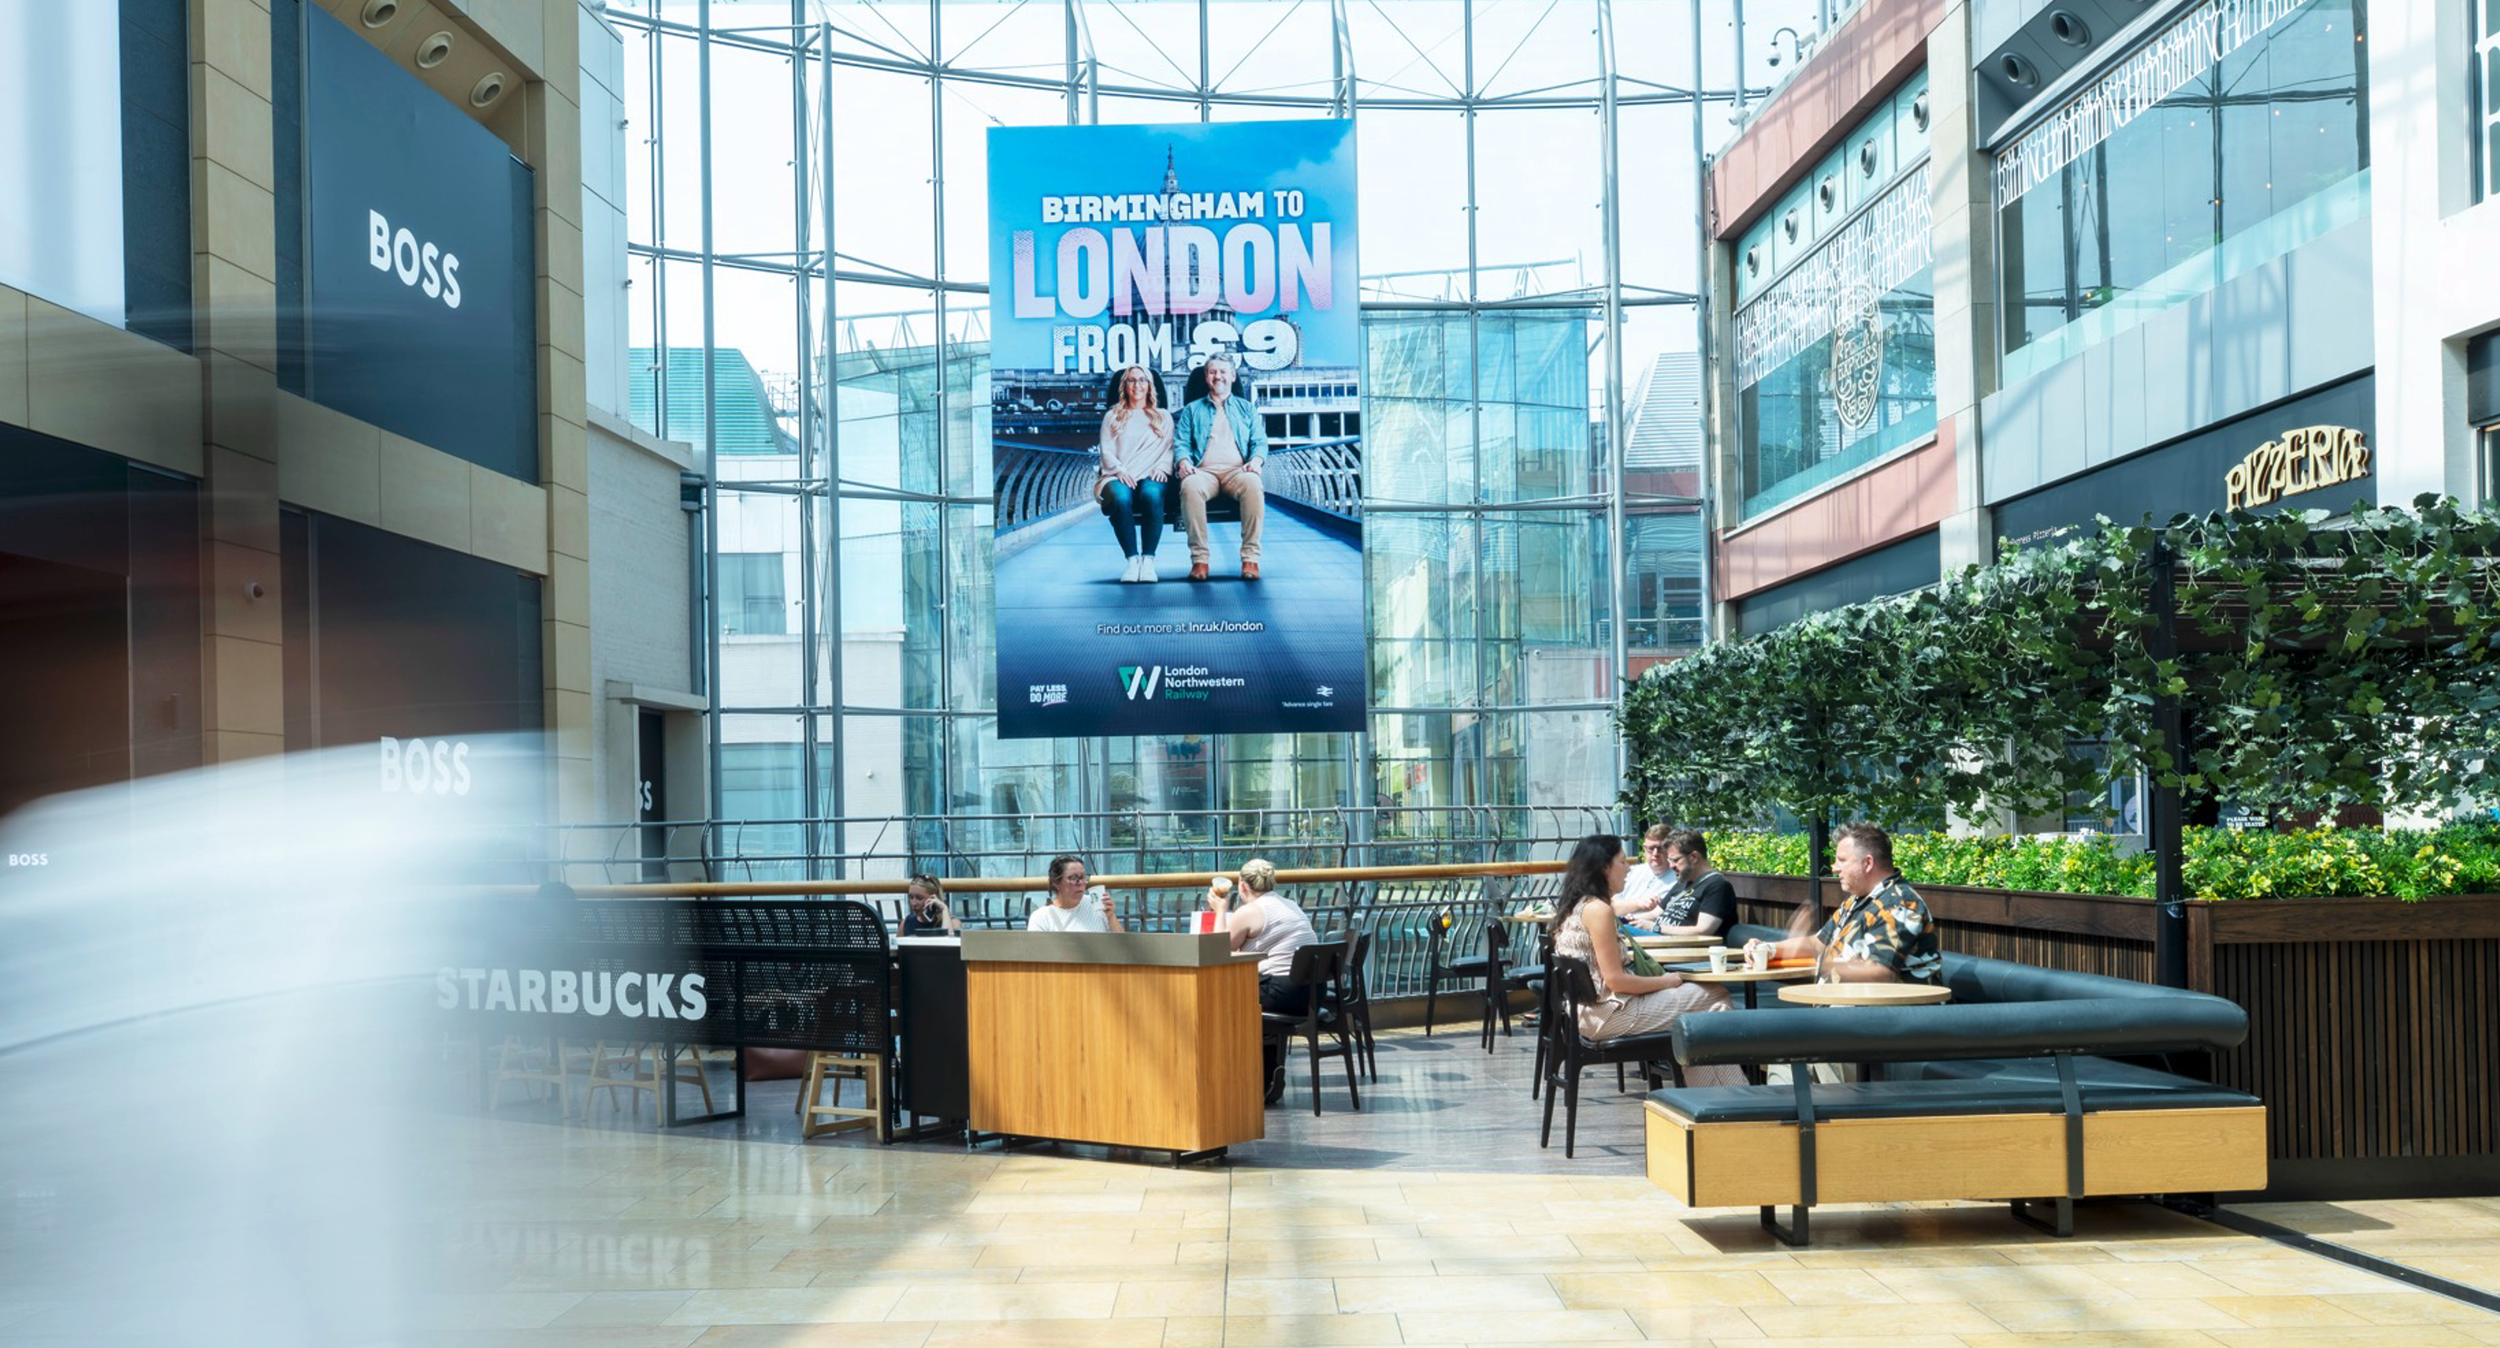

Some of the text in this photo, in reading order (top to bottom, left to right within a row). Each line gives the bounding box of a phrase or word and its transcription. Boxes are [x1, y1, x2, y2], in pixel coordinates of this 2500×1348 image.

[1042, 190, 1304, 223] BIRMINGHAM TO
[370, 208, 461, 309] BOSS
[1013, 222, 1333, 318] LONDON
[1053, 318, 1298, 375] FROM £9
[2224, 424, 2369, 513] PIZZERIA
[1097, 620, 1264, 635] Find out more at lnr.uk/london
[1165, 664, 1209, 677] London
[1165, 676, 1245, 688] Northwestern
[1030, 684, 1067, 693] PAY LESS
[1030, 692, 1067, 703] DO MORE
[1165, 688, 1209, 701] Railway
[381, 736, 471, 796] BOSS
[9, 853, 49, 866] BOSS
[437, 966, 707, 1021] STARBUCKS
